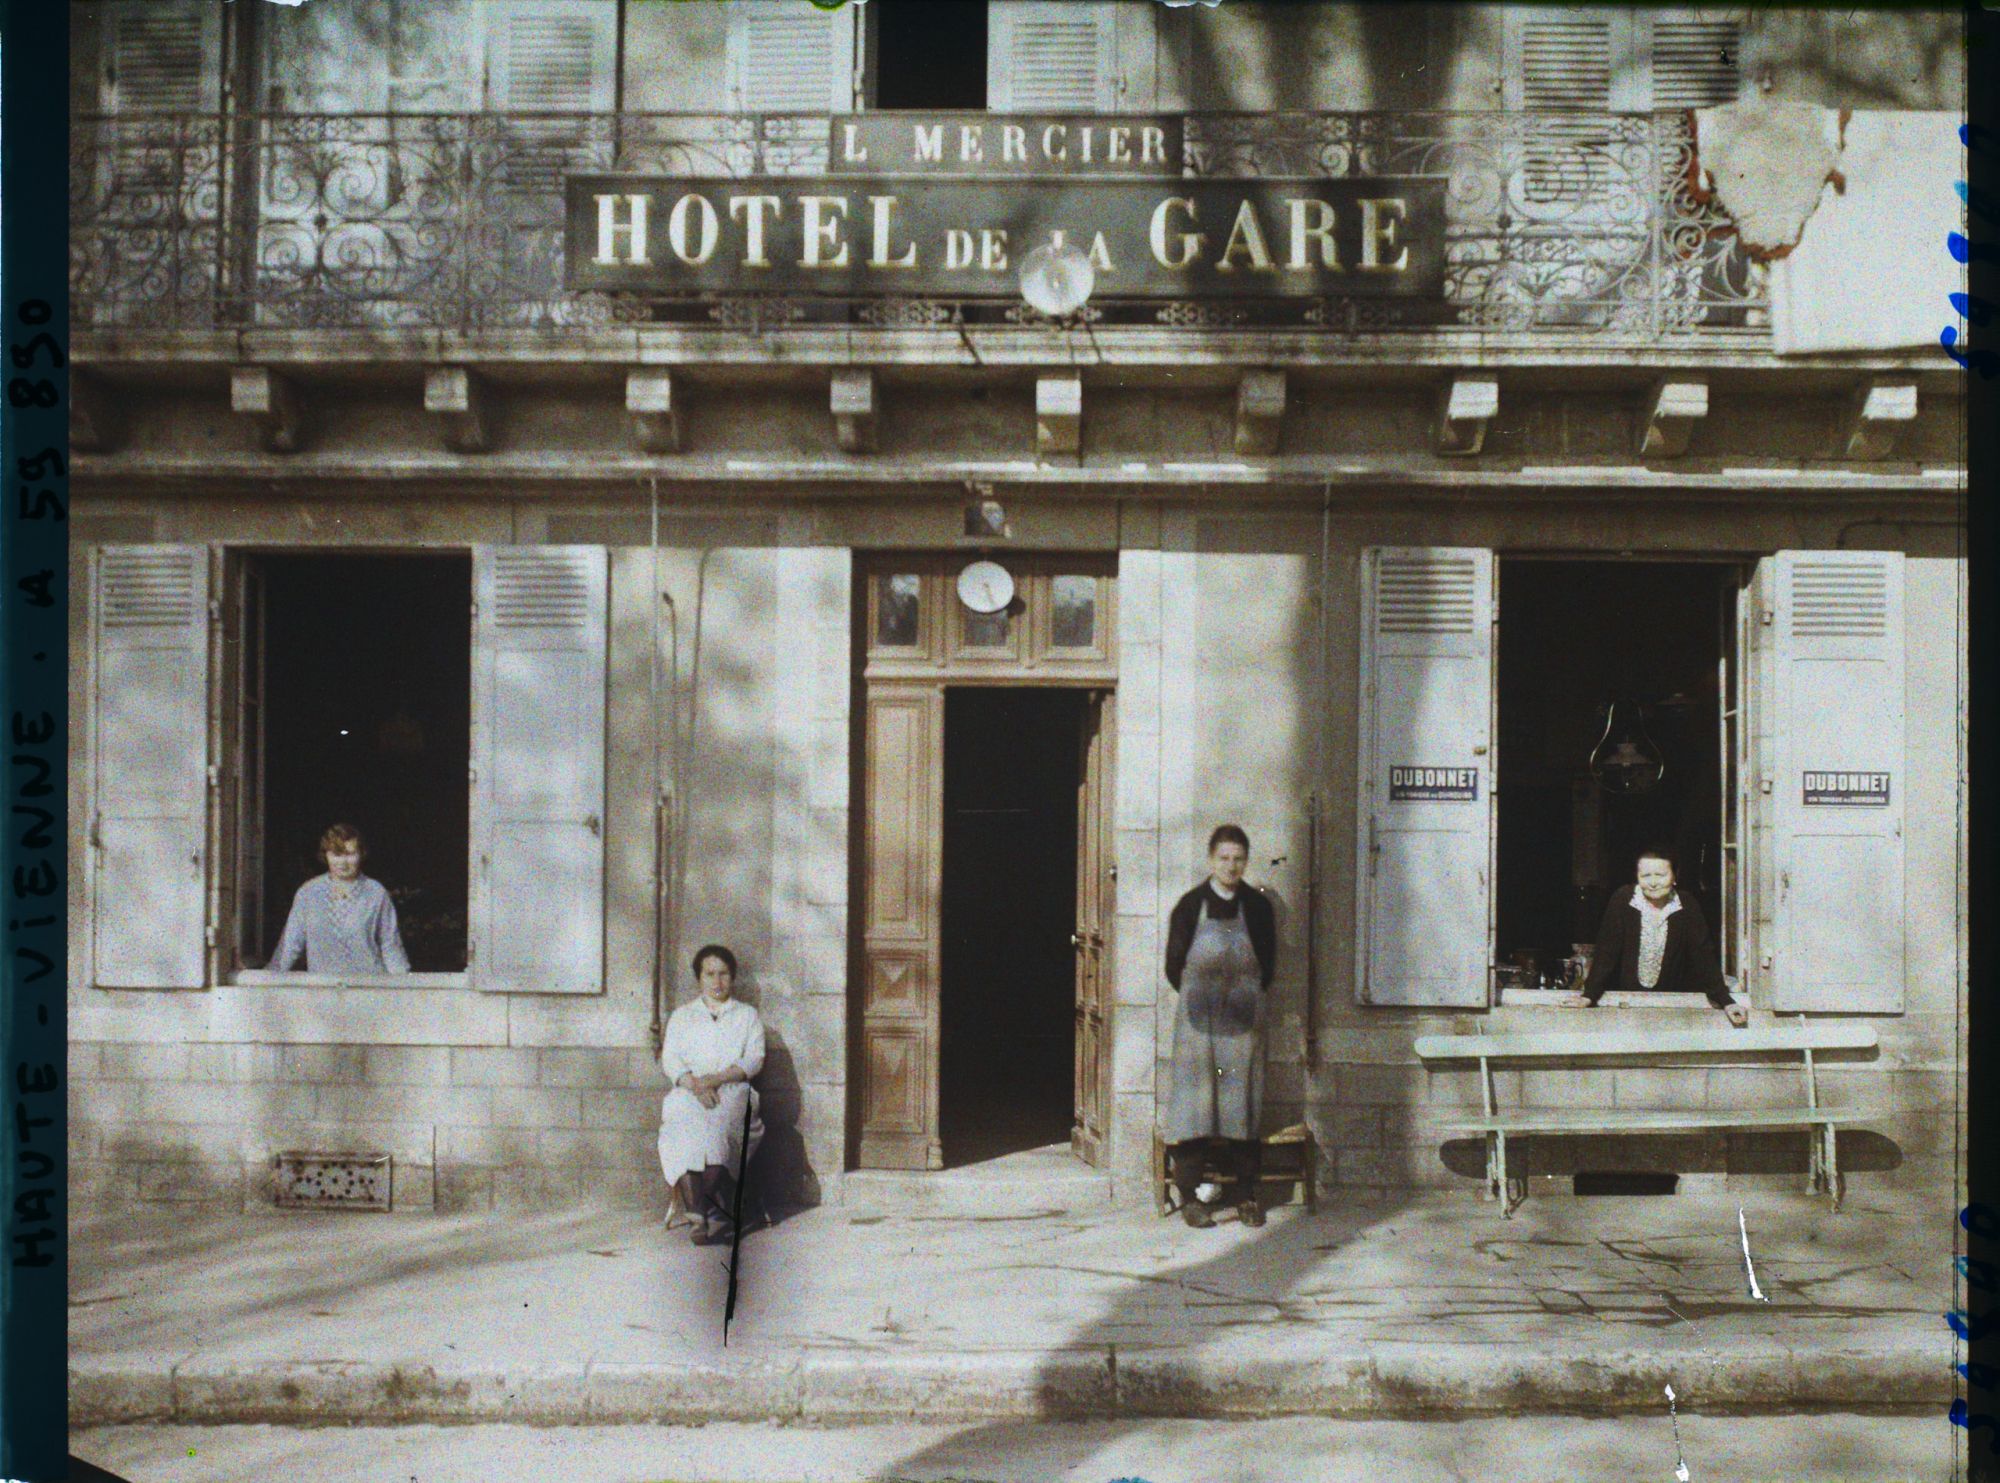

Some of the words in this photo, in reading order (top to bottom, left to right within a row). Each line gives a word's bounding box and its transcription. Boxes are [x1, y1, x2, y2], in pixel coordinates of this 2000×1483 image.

[843, 124, 868, 163] L
[913, 123, 1169, 165] MERCIER
[590, 193, 919, 268] HOTEL
[944, 229, 1009, 271] DE
[1149, 196, 1410, 272] GARE
[1392, 768, 1477, 788] DUBONNET
[1804, 773, 1889, 792] DUBONNET
